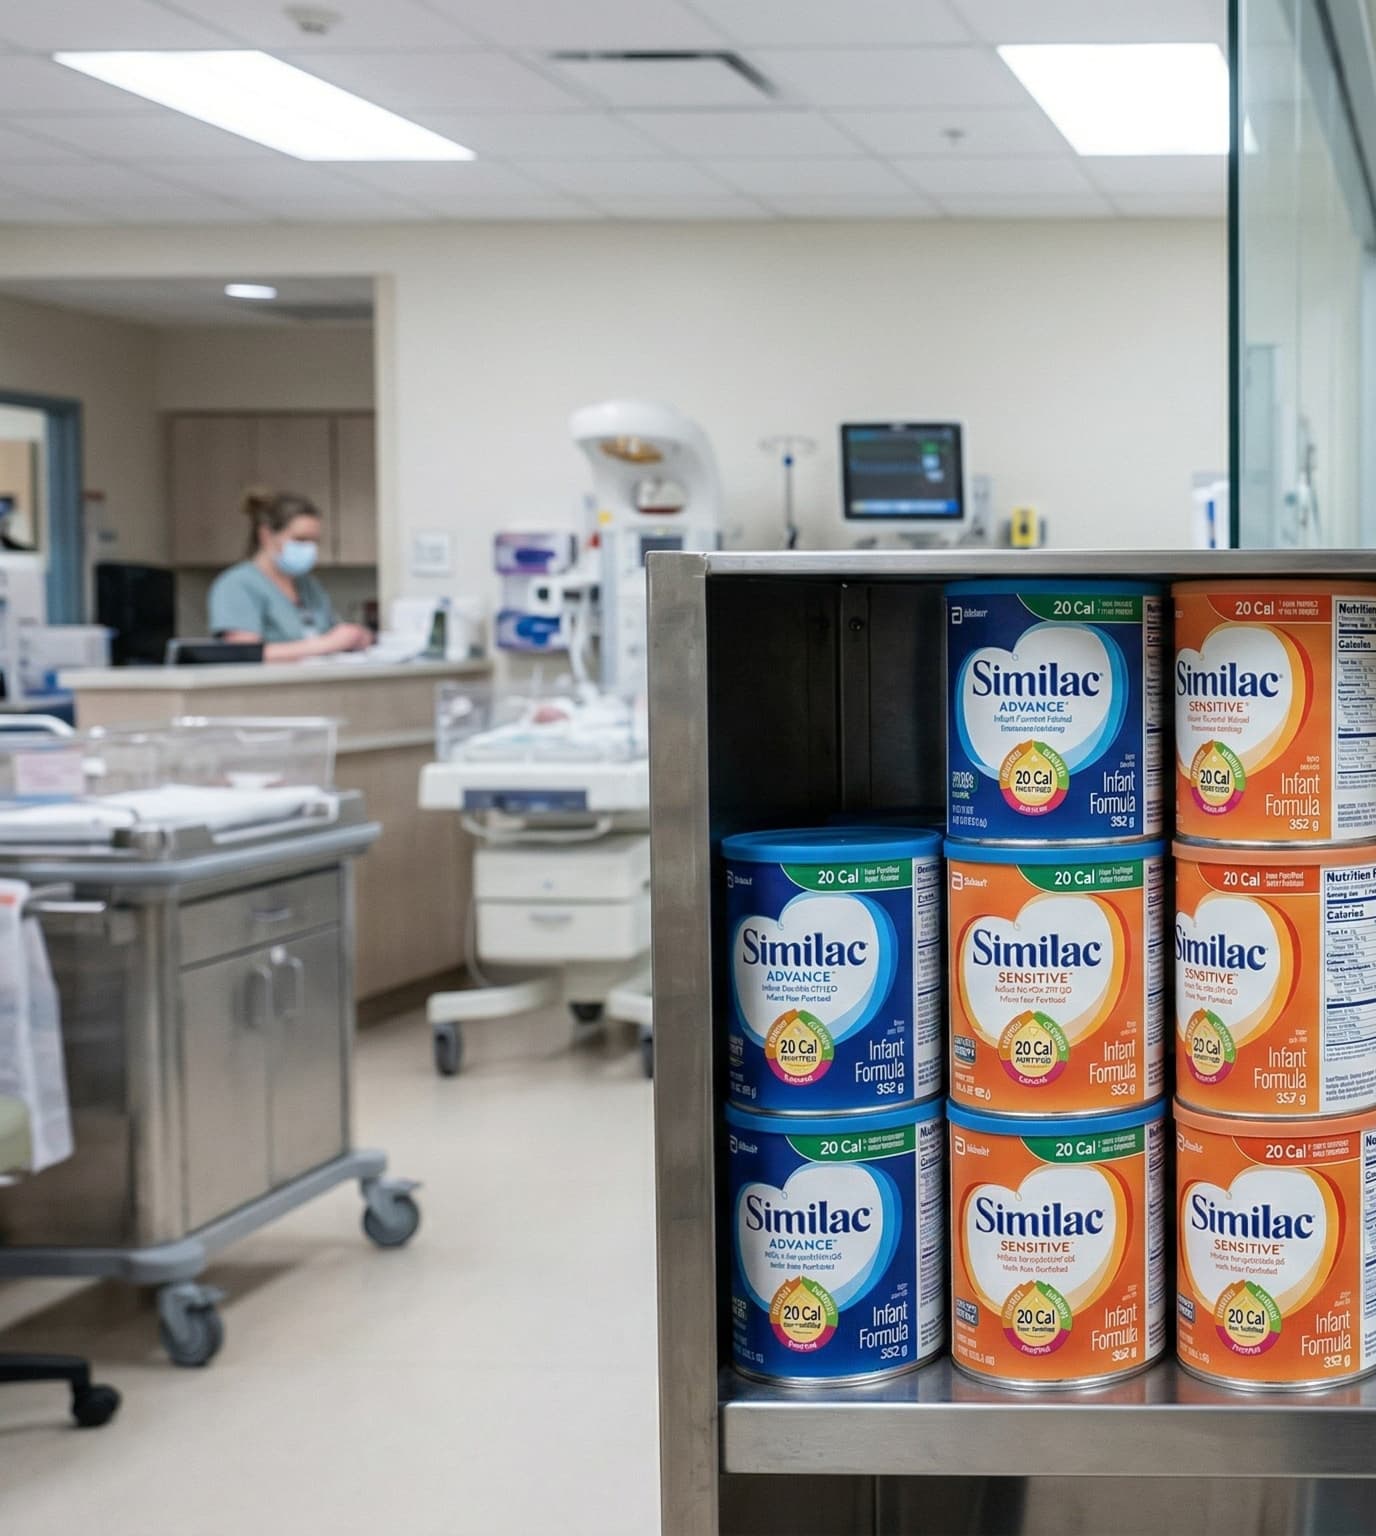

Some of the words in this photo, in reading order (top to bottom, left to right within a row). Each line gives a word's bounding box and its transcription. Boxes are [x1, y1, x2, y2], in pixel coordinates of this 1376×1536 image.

[1053, 602, 1071, 615] 20
[1074, 601, 1094, 615] Cal
[1235, 602, 1251, 615] 20
[1254, 602, 1274, 615] Cal
[972, 660, 1100, 697] Similac
[1177, 661, 1279, 697] Similac
[1000, 701, 1064, 712] ADVANCE
[1189, 702, 1243, 712] SENSITIVE
[1016, 771, 1031, 784] 20
[1034, 770, 1052, 785] Cal
[1103, 772, 1135, 792] Infant
[1200, 769, 1212, 784] 20
[1214, 769, 1229, 785] Cal
[1281, 773, 1320, 794] Infant
[1090, 793, 1135, 815] Formula
[1266, 794, 1320, 816] Formula
[818, 871, 835, 884] 20
[838, 870, 859, 884] Cal
[1054, 871, 1071, 885] 20
[1074, 870, 1095, 885] Cal
[1223, 872, 1237, 886] 20
[1241, 872, 1260, 886] Cal
[743, 928, 867, 967] Similac
[973, 929, 1101, 967] Similac
[1176, 924, 1267, 970] Similac
[766, 971, 831, 982] ADVANCE
[998, 972, 1068, 984] SENSITIVE
[781, 1040, 796, 1054] 20
[799, 1040, 817, 1054] Cal
[869, 1040, 904, 1061] Infant
[1015, 1041, 1031, 1055] 20
[1034, 1041, 1052, 1055] Cal
[1193, 1037, 1205, 1053] 20
[1206, 1039, 1220, 1055] Cal
[1269, 1048, 1306, 1068] Infant
[855, 1061, 904, 1082] Formula
[1090, 1062, 1136, 1084] Formula
[1254, 1070, 1306, 1089] Formula
[820, 1142, 838, 1154] 20
[841, 1140, 862, 1154] Cal
[1056, 1143, 1073, 1156] 20
[1076, 1142, 1095, 1155] Cal
[1266, 1145, 1283, 1158] 20
[1286, 1145, 1306, 1158] Cal
[746, 1195, 871, 1235] Similac
[976, 1197, 1104, 1237] Similac
[1191, 1195, 1314, 1239] Similac
[769, 1239, 833, 1250] ADVANCE
[1001, 1241, 1070, 1252] SENSITIVE
[1214, 1239, 1280, 1255] SENSITIVE
[784, 1305, 800, 1320] 20
[802, 1305, 821, 1321] Cal
[873, 1304, 908, 1325] Infant
[1017, 1310, 1033, 1324] 20
[1035, 1310, 1055, 1325] Cal
[1105, 1304, 1137, 1325] Infant
[1228, 1309, 1244, 1324] 20
[1246, 1310, 1265, 1325] Cal
[1316, 1311, 1350, 1332] Infant
[860, 1325, 908, 1349] Formula
[1092, 1328, 1138, 1351] Formula
[1301, 1333, 1351, 1356] Formula
